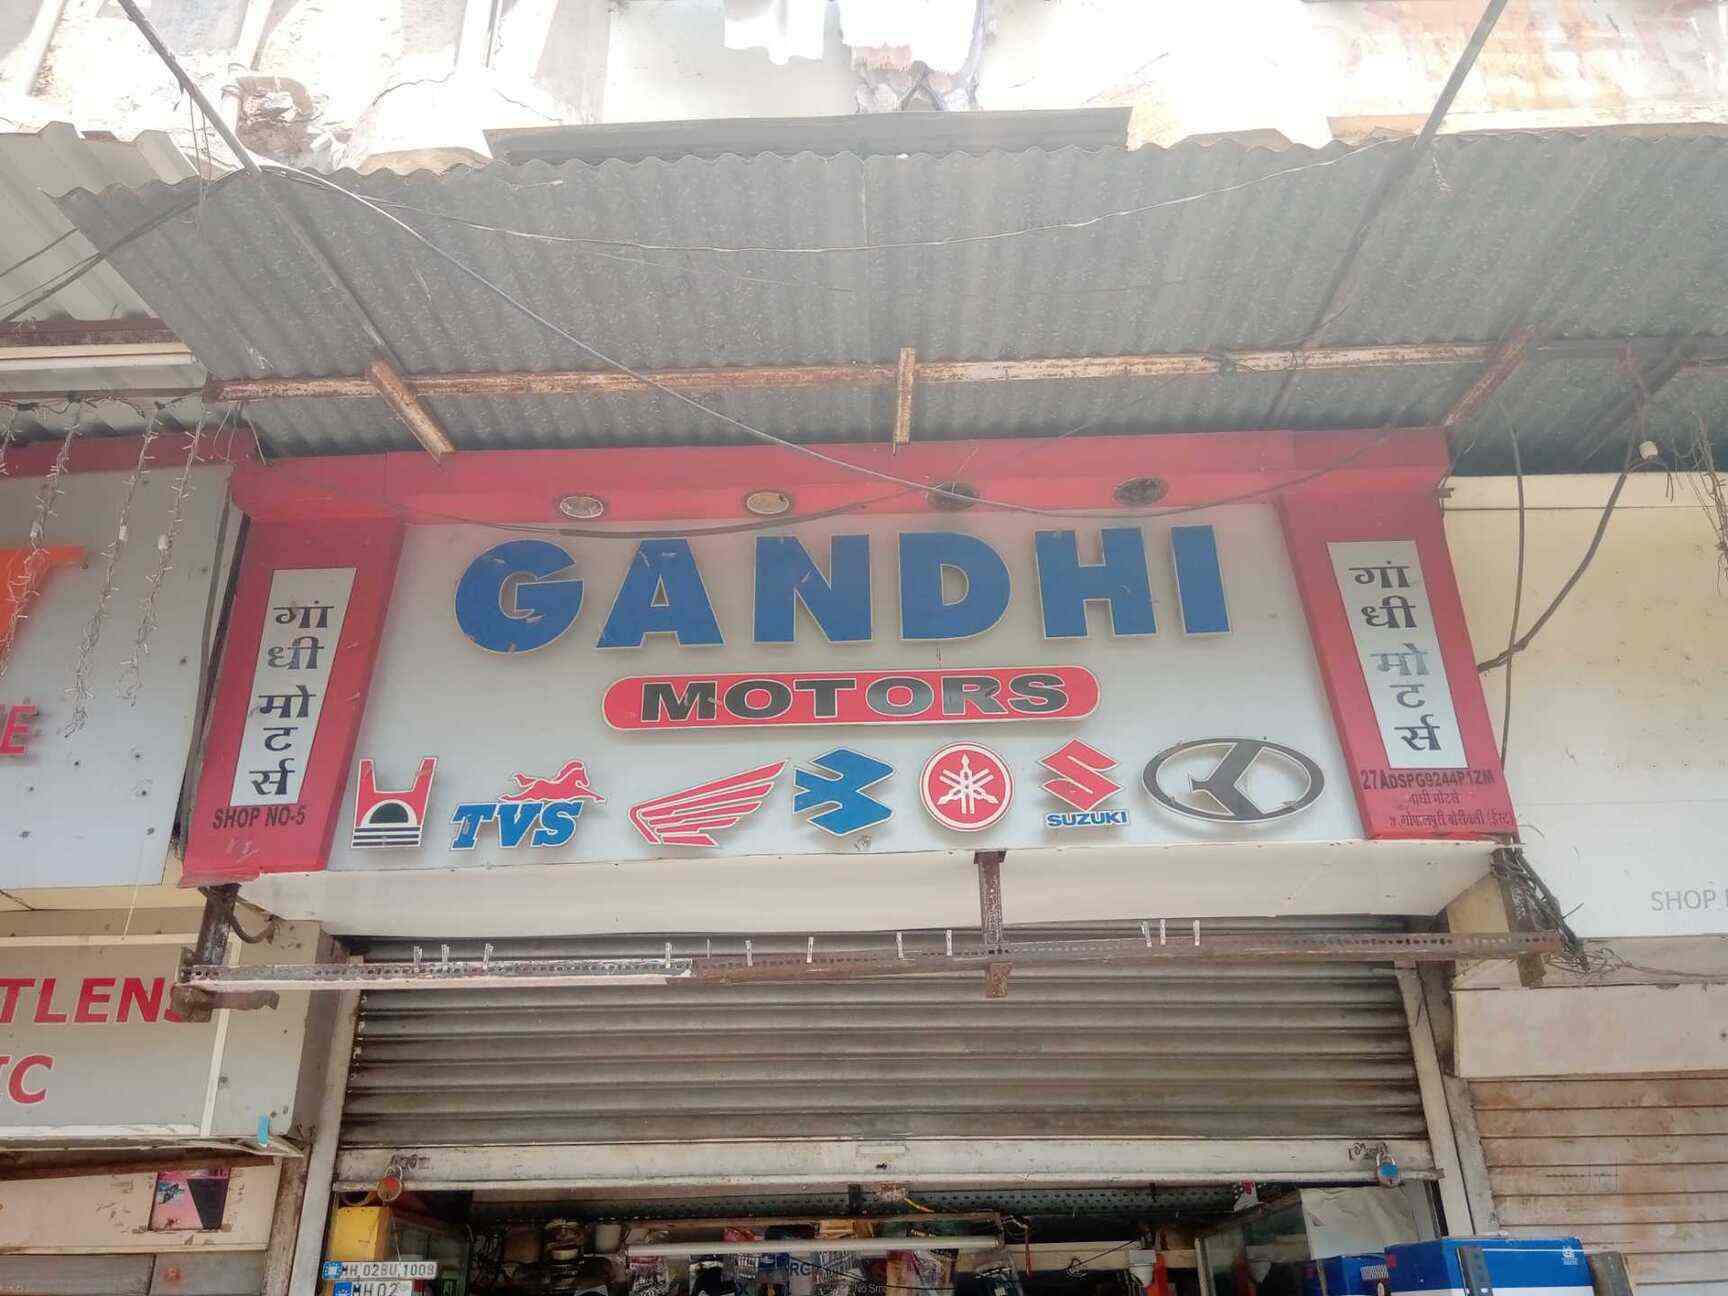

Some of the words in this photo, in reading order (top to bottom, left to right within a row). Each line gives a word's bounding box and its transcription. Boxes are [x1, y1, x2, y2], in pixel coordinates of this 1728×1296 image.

[454, 524, 1231, 654] GANDHI
[1348, 562, 1418, 630] गांधी
[267, 600, 334, 671] गांधी
[641, 674, 1068, 722] MOTORS
[249, 684, 315, 797] मोटर्स
[213, 806, 260, 829] SHOP
[265, 804, 306, 827] NO-5
[450, 801, 583, 850] TVS
[1047, 811, 1128, 826] SUZUKI
[1651, 889, 1716, 911] SHOP
